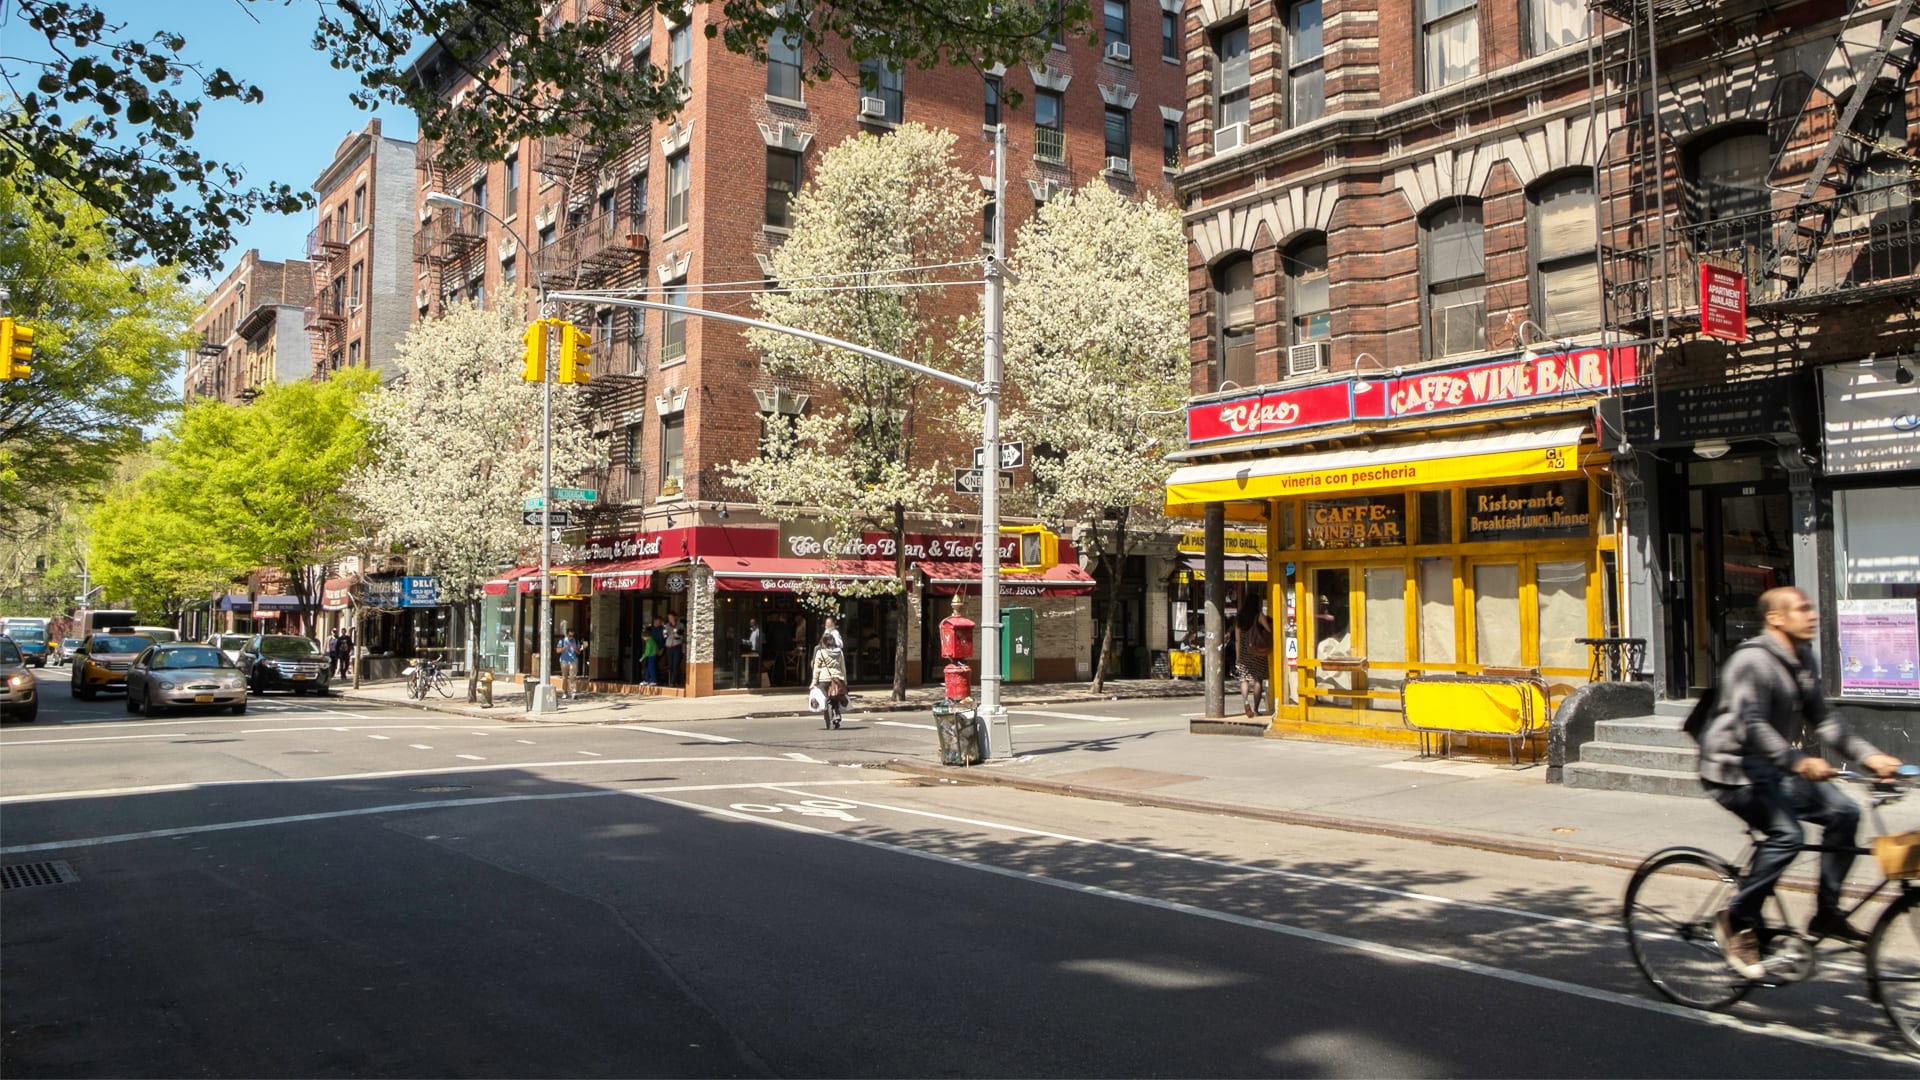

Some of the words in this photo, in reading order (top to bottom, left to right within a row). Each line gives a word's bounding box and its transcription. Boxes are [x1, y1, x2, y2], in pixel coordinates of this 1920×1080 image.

[1708, 284, 1741, 300] APARTMENT
[1710, 294, 1739, 308] AVAILABLE
[1391, 376, 1468, 414] CAFFE
[1467, 361, 1532, 401] WINE
[1537, 353, 1603, 395] BAR
[1229, 401, 1299, 432] Ciao
[964, 476, 982, 486] ONE
[1281, 474, 1321, 488] vineria
[1325, 472, 1348, 485] con
[1351, 465, 1417, 485] pescheria
[1478, 490, 1565, 513] Ristorante
[528, 514, 542, 522] ONE
[1471, 513, 1521, 532] Breakfast
[1552, 511, 1590, 528] Dinner
[1312, 525, 1350, 541] WINE
[1353, 522, 1400, 539] BAR
[592, 543, 613, 560] Bean
[613, 540, 623, 557] &
[621, 538, 637, 557] Tea
[637, 536, 662, 555] Leaf
[788, 536, 821, 556] The
[823, 538, 877, 556] Cffee
[877, 539, 926, 558] Ban
[928, 540, 943, 556] &
[944, 540, 974, 557] Tea
[1239, 538, 1258, 549] GRILL
[412, 580, 433, 588] DELI
[1000, 586, 1014, 596] Est.
[1015, 586, 1036, 596] 1963
[1289, 641, 1297, 654] A
